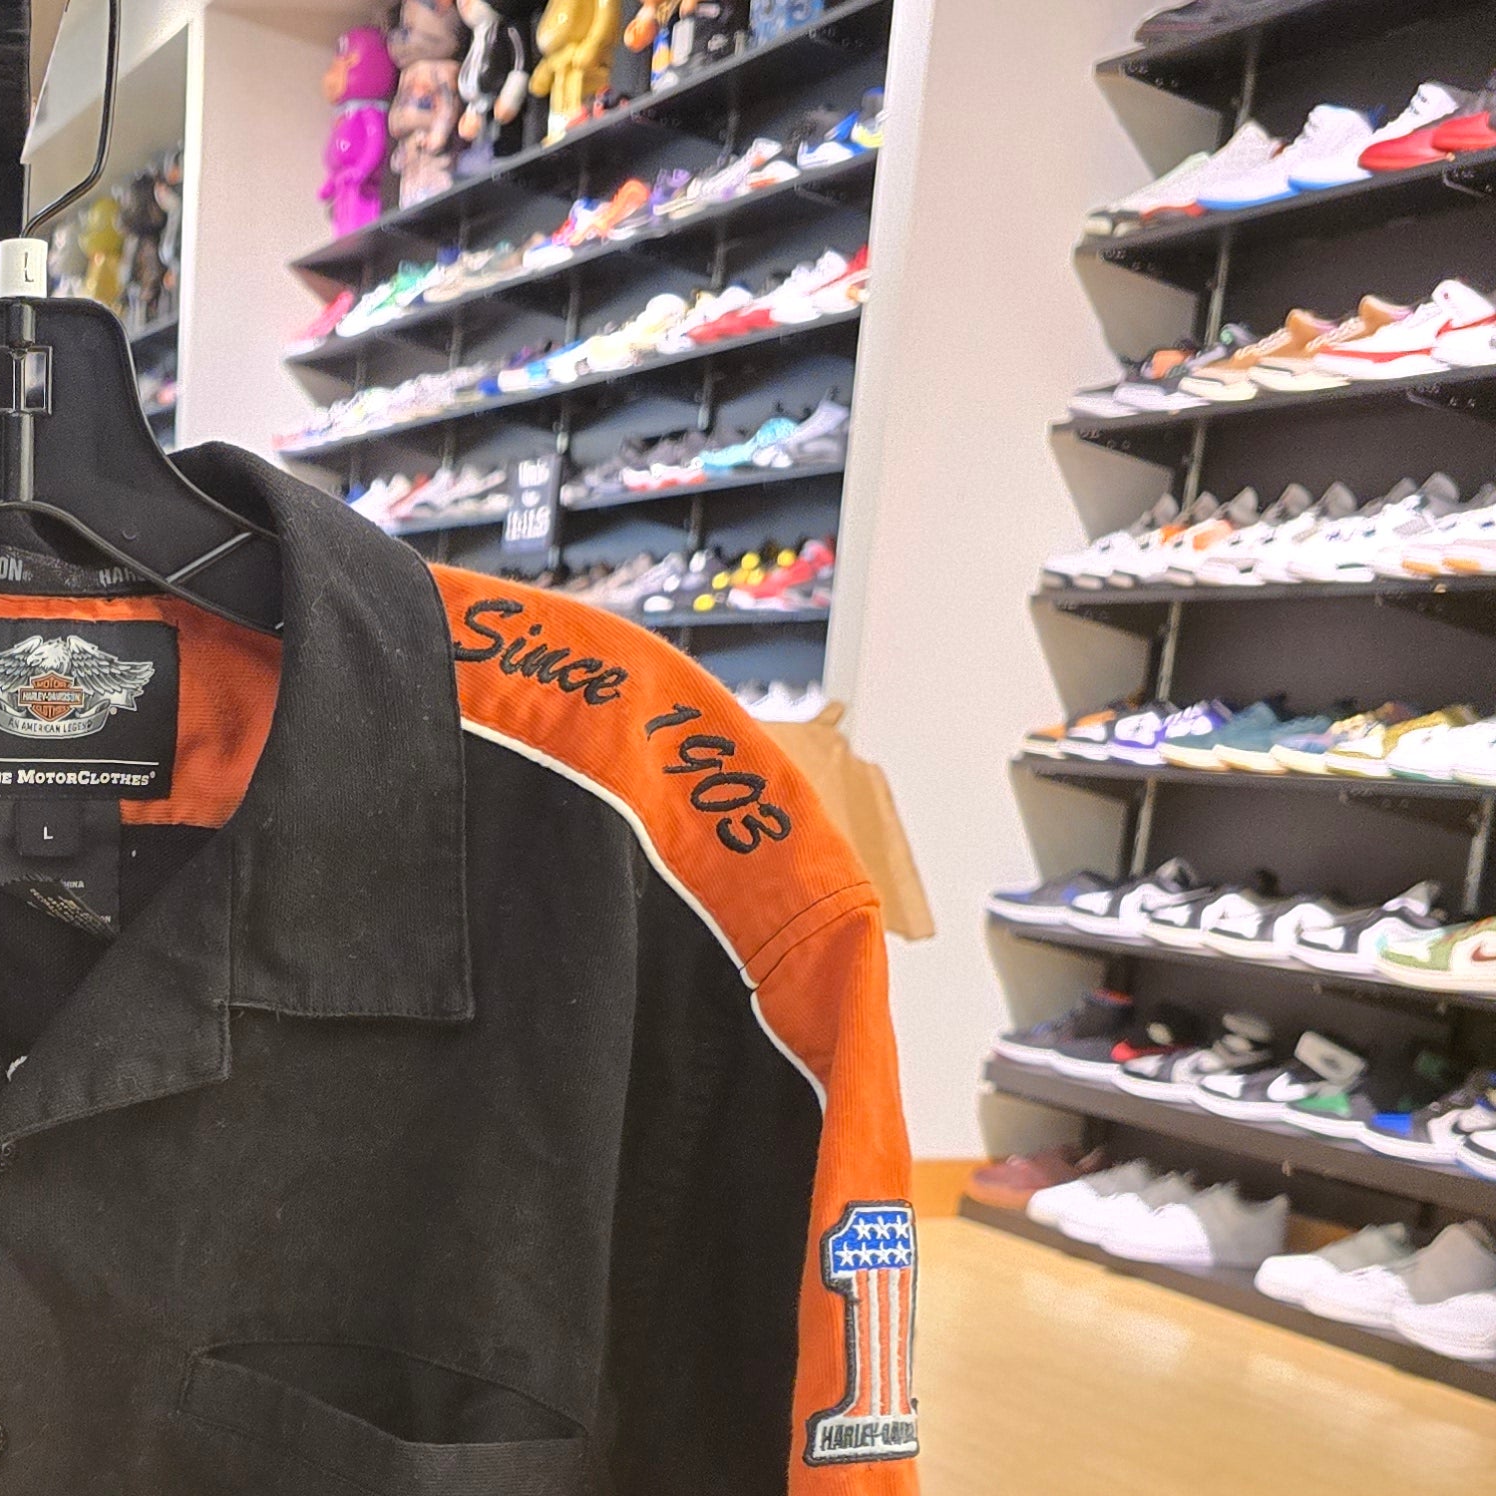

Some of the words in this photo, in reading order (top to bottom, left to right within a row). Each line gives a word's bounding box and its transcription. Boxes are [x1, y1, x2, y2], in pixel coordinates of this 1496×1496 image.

[454, 598, 629, 706] Since
[644, 702, 792, 854] 1903
[44, 827, 54, 839] L
